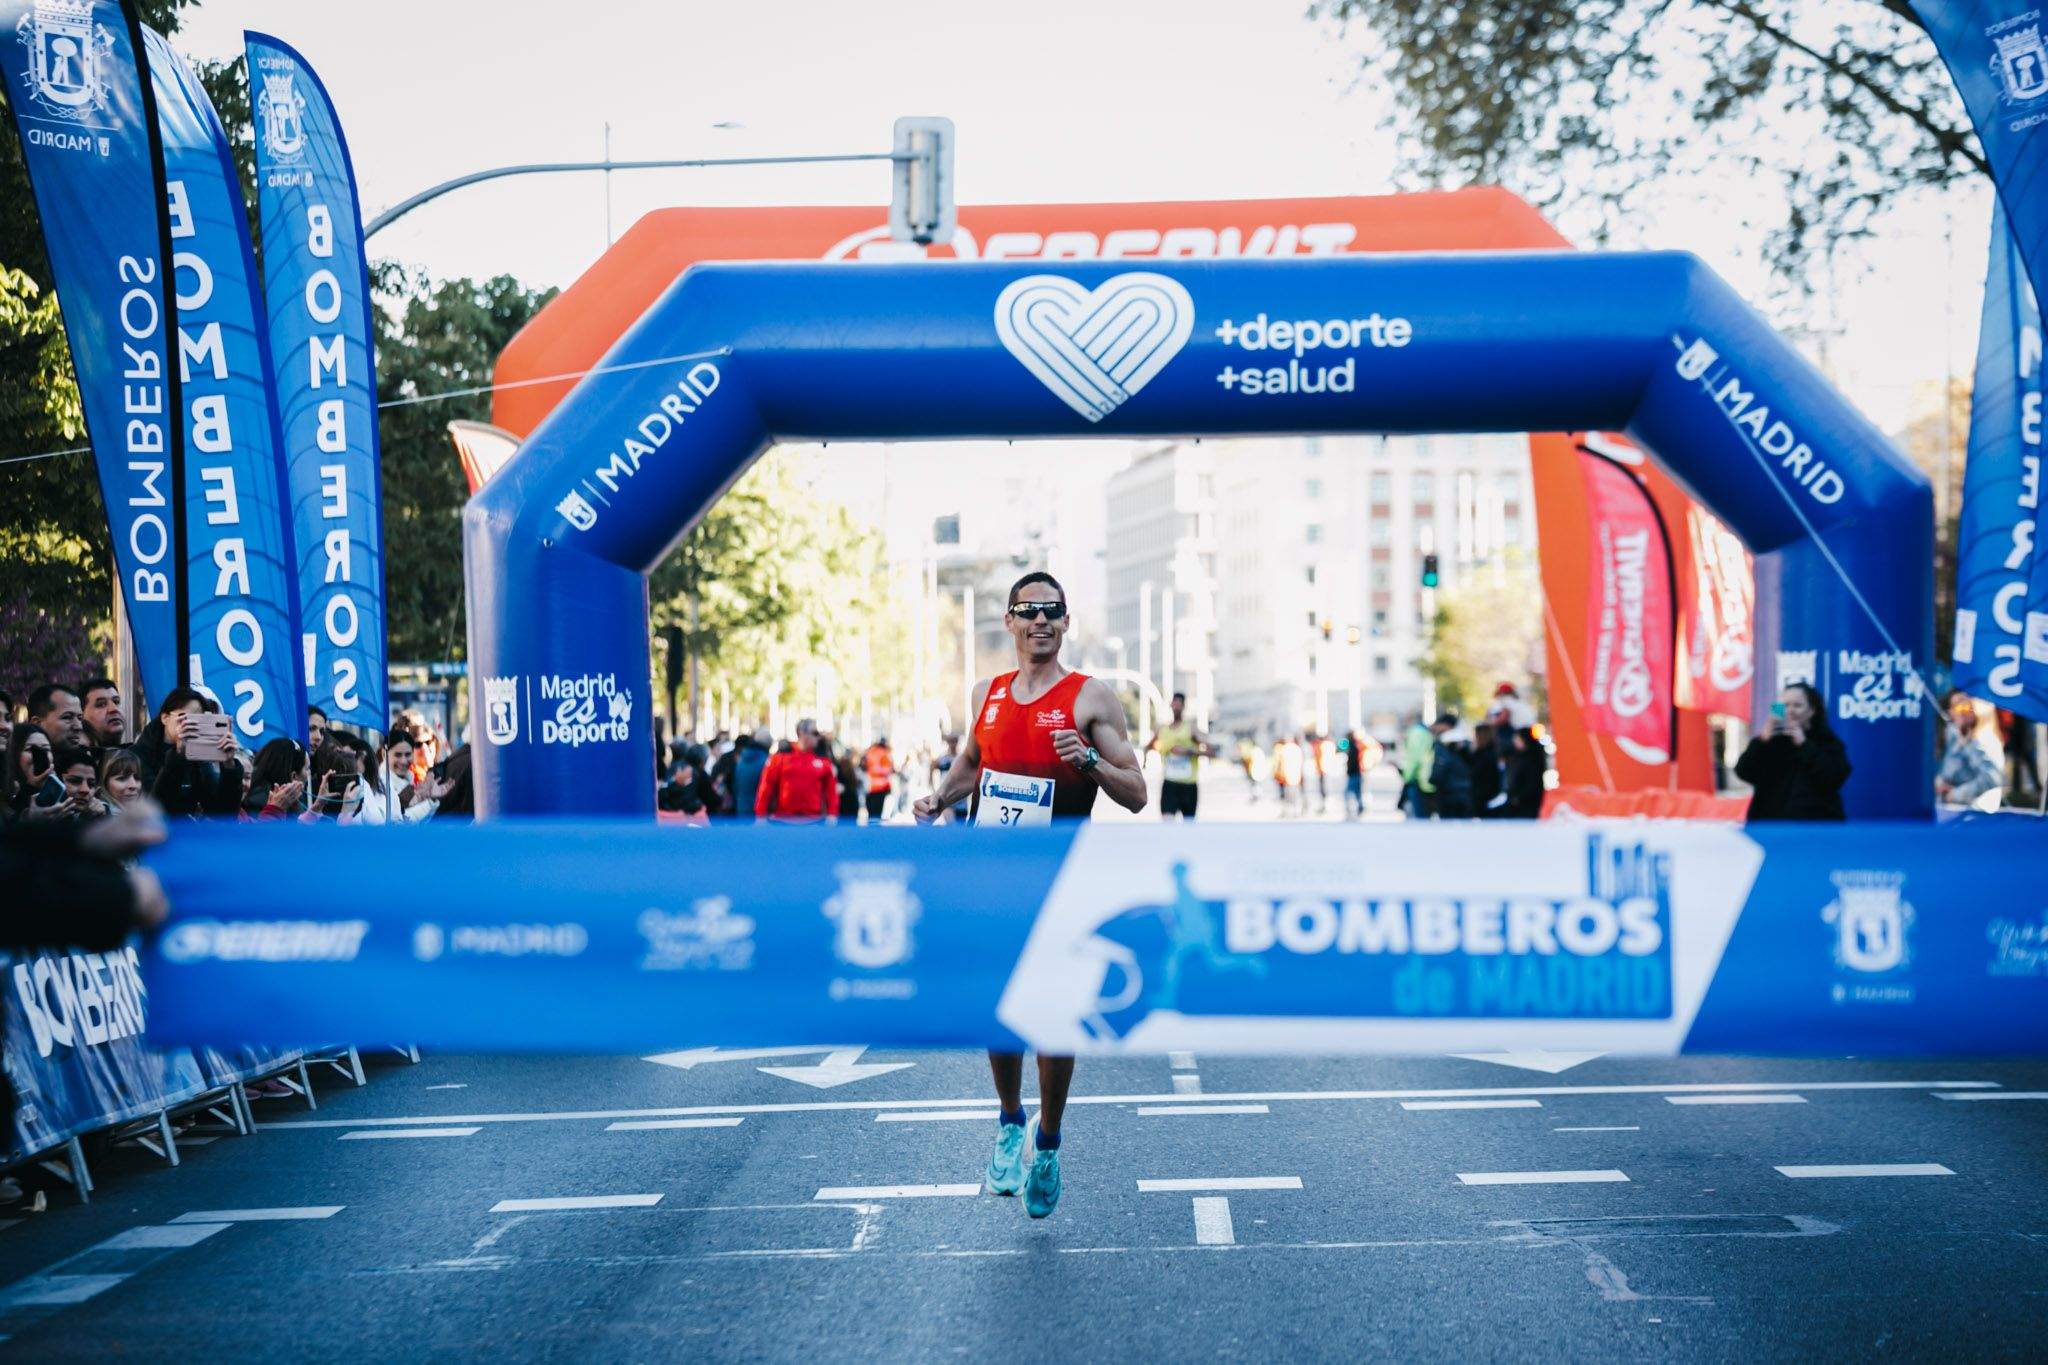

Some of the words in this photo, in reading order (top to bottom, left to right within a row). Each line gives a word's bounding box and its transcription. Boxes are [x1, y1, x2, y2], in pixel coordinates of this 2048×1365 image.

[595, 362, 721, 493] MADRID
[1713, 377, 1845, 505] MADRID
[1839, 650, 1912, 674] Madrid
[541, 673, 616, 699] Madrid
[556, 697, 598, 725] es
[542, 720, 629, 748] Deporte
[1000, 805, 1023, 827] 37
[1224, 897, 1664, 957] BOMBEROS
[1393, 957, 1455, 1013] de
[1470, 956, 1664, 1013] MADRID
